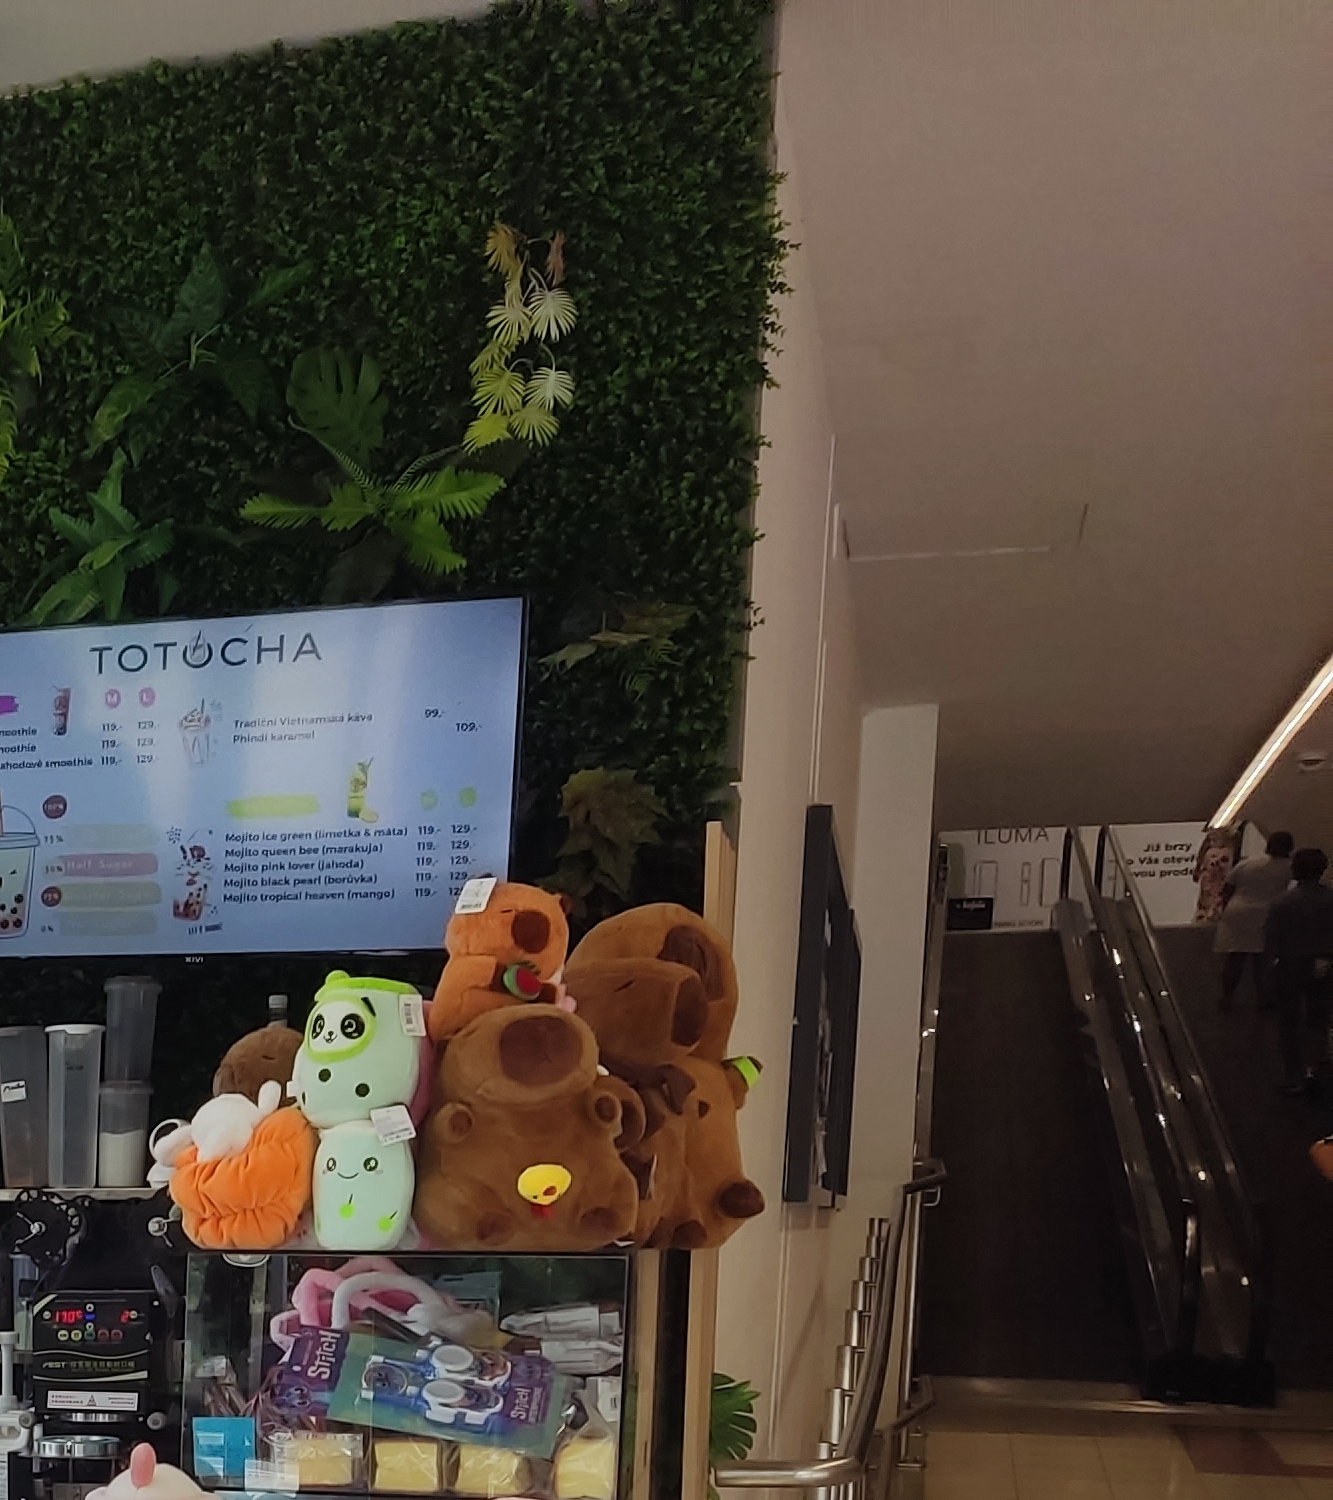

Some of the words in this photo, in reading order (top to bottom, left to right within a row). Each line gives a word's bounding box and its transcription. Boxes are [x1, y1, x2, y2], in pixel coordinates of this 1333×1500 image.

[89, 632, 322, 675] TOTOCHA
[225, 832, 259, 845] Mojito
[262, 831, 277, 841] ice
[280, 831, 312, 842] green
[225, 847, 259, 859] Mojito
[261, 846, 296, 858] queen
[299, 845, 319, 855] bee
[224, 862, 259, 874] Mojito
[261, 861, 285, 873] pink
[288, 860, 315, 870] lover
[318, 858, 364, 871] (jahoda)
[224, 877, 258, 890] Mojito
[261, 876, 291, 886] black
[294, 875, 321, 887] pearl
[223, 893, 257, 905] Mojito
[260, 892, 302, 904] tropical
[304, 891, 344, 900] heaven
[347, 889, 395, 900] (mango)
